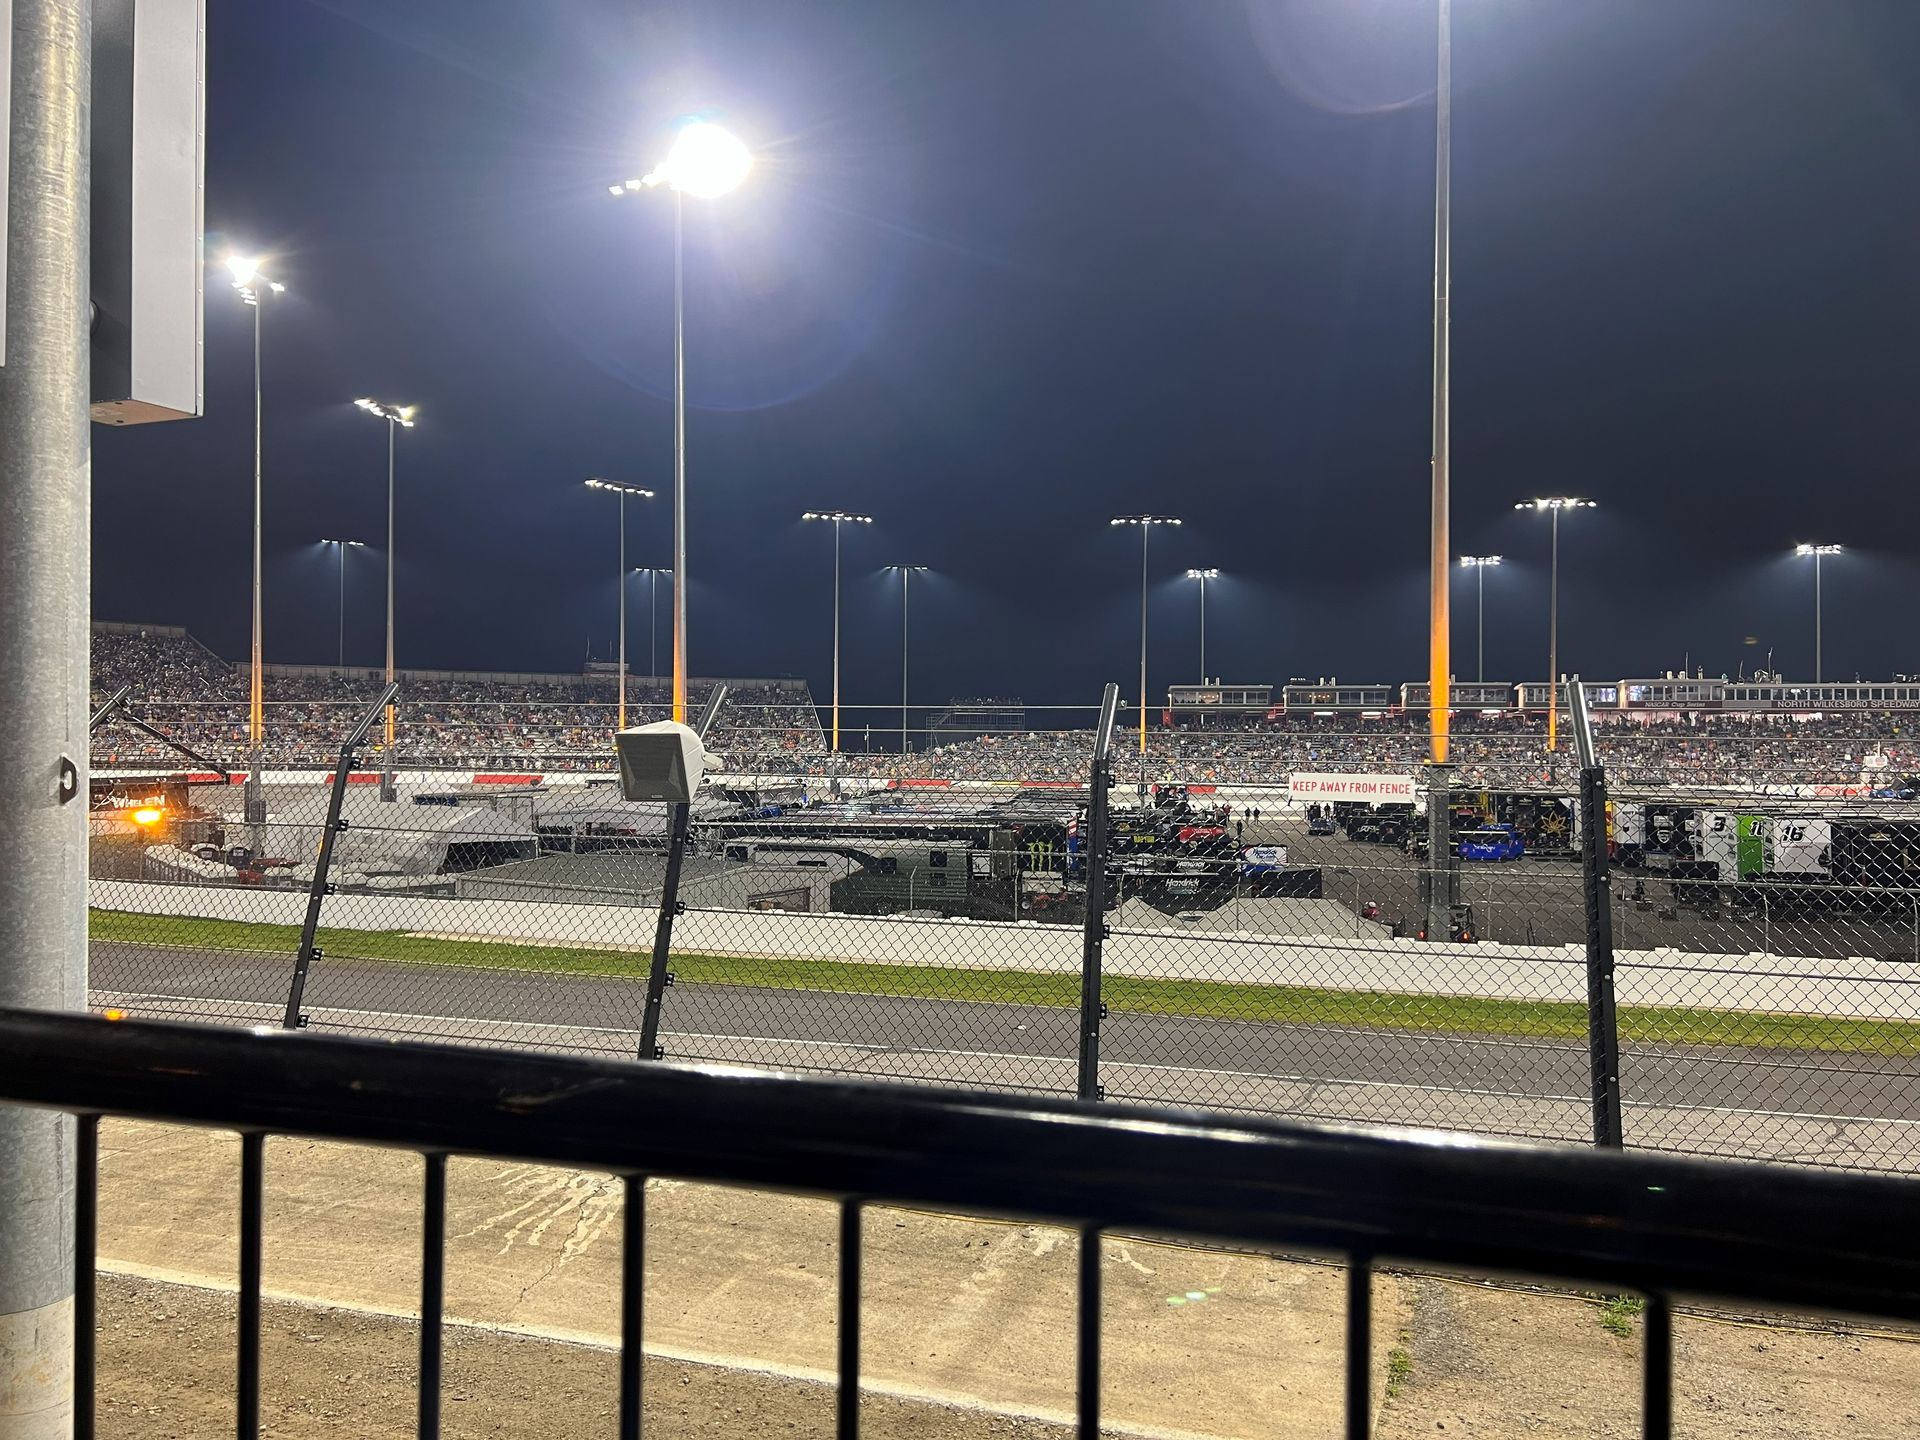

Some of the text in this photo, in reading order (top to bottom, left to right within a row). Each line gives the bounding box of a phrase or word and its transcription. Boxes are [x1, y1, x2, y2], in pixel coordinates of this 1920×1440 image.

[1293, 781, 1411, 795] KEEP AWAY FROM FENCE
[113, 795, 165, 808] WHELEN
[1781, 824, 1806, 842] 16
[1165, 878, 1200, 887] Hendrick
